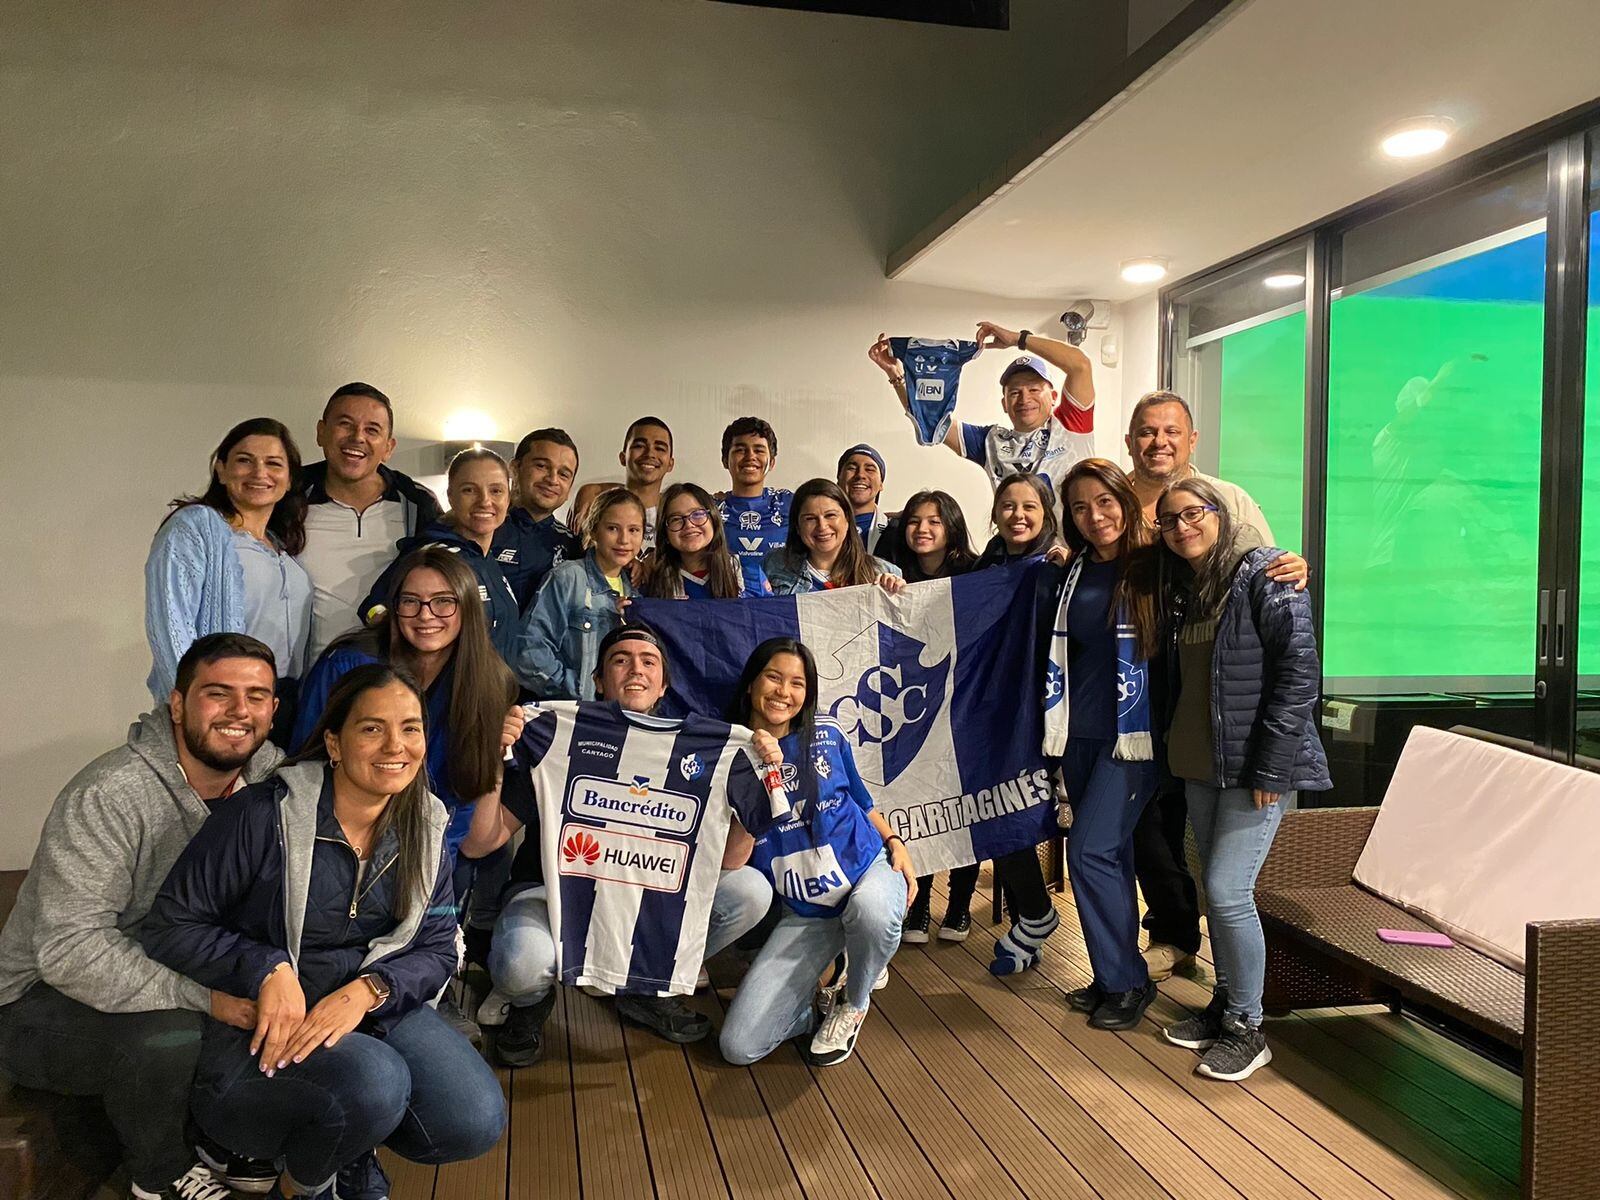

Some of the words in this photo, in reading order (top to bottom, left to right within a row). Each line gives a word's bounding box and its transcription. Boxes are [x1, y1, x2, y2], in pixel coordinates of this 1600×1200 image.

[577, 741, 619, 752] MUNICIPALIDAD
[581, 748, 615, 759] CARTAGO
[582, 789, 687, 822] Bancrédito
[888, 768, 1052, 842] CARTAGINÉS
[603, 848, 676, 874] HUAWEI
[804, 870, 843, 898] BN
